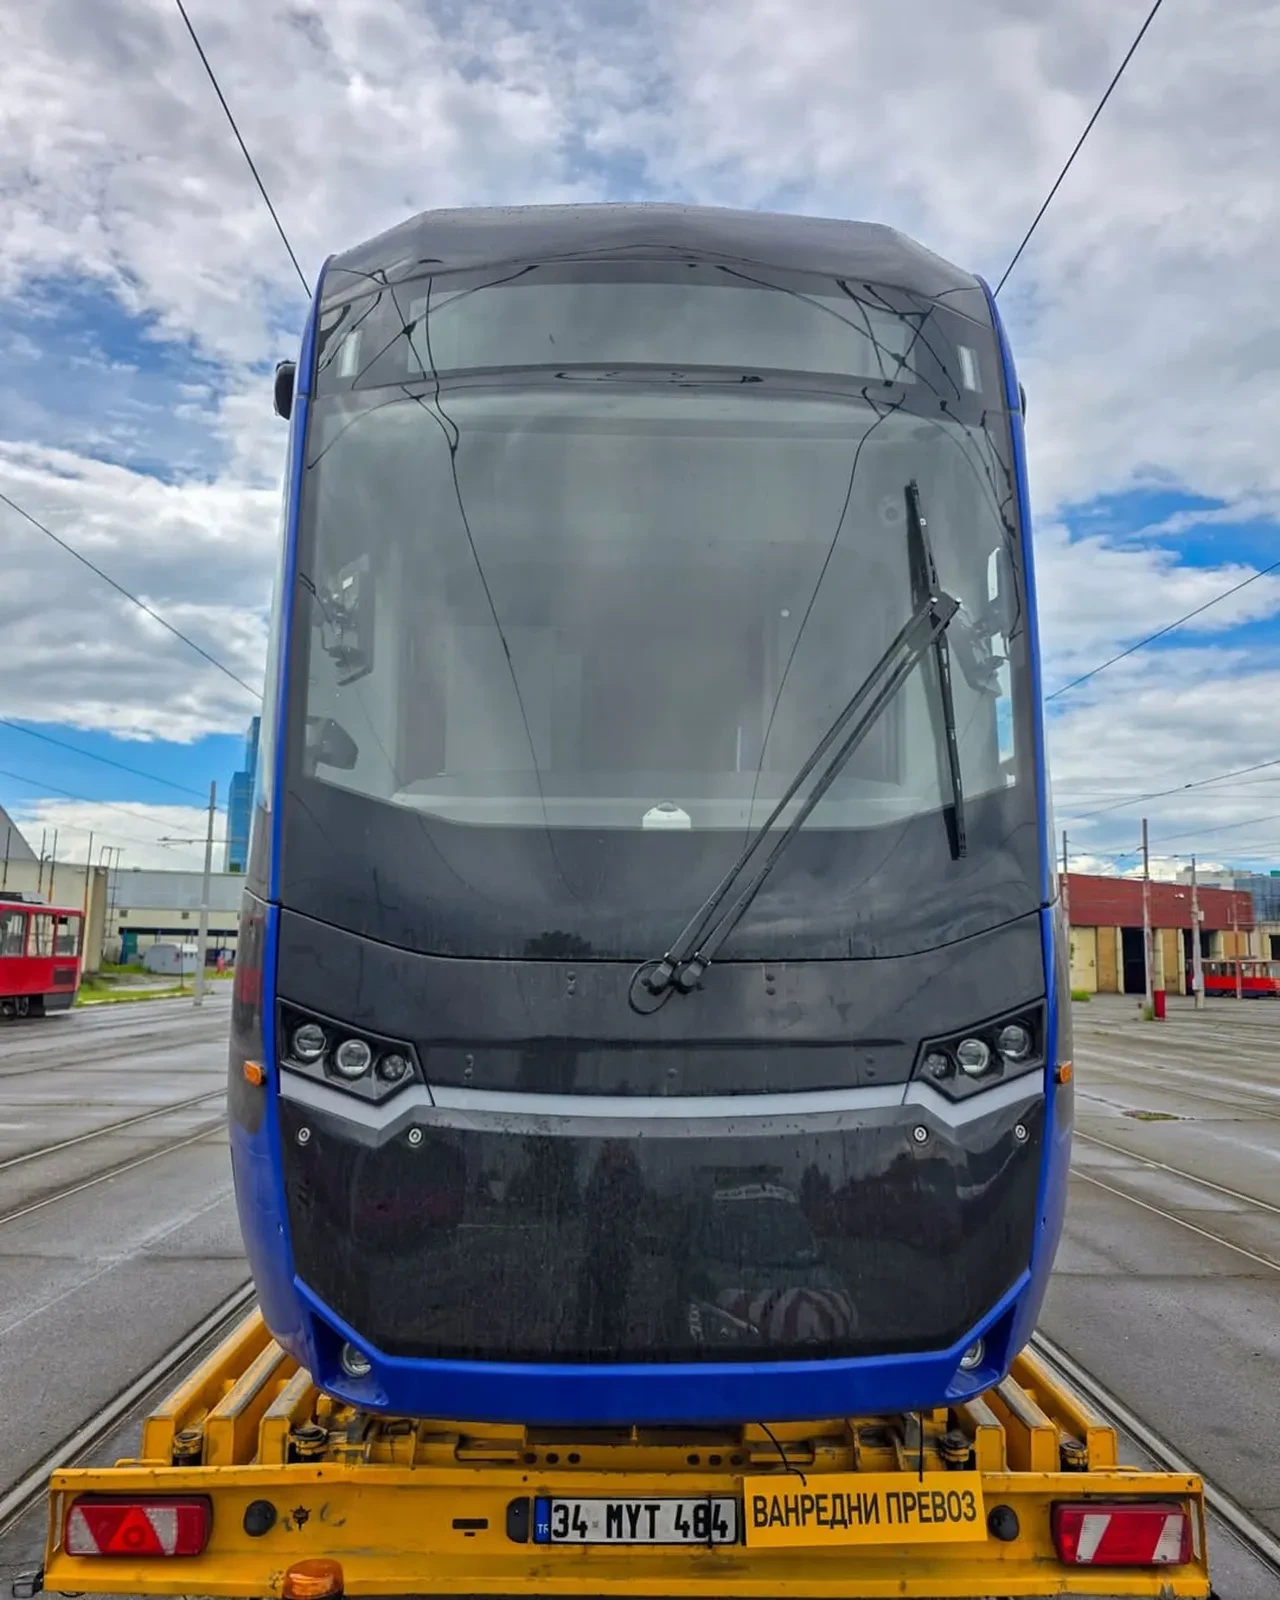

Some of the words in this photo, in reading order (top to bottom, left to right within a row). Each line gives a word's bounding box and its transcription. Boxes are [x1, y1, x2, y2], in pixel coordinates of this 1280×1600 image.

[552, 1504, 588, 1538] 34
[606, 1504, 661, 1538] MYT
[674, 1504, 728, 1538] 484
[752, 1492, 881, 1529] ВАНРЕДНИ
[885, 1490, 977, 1524] ПРЕВОЗ
